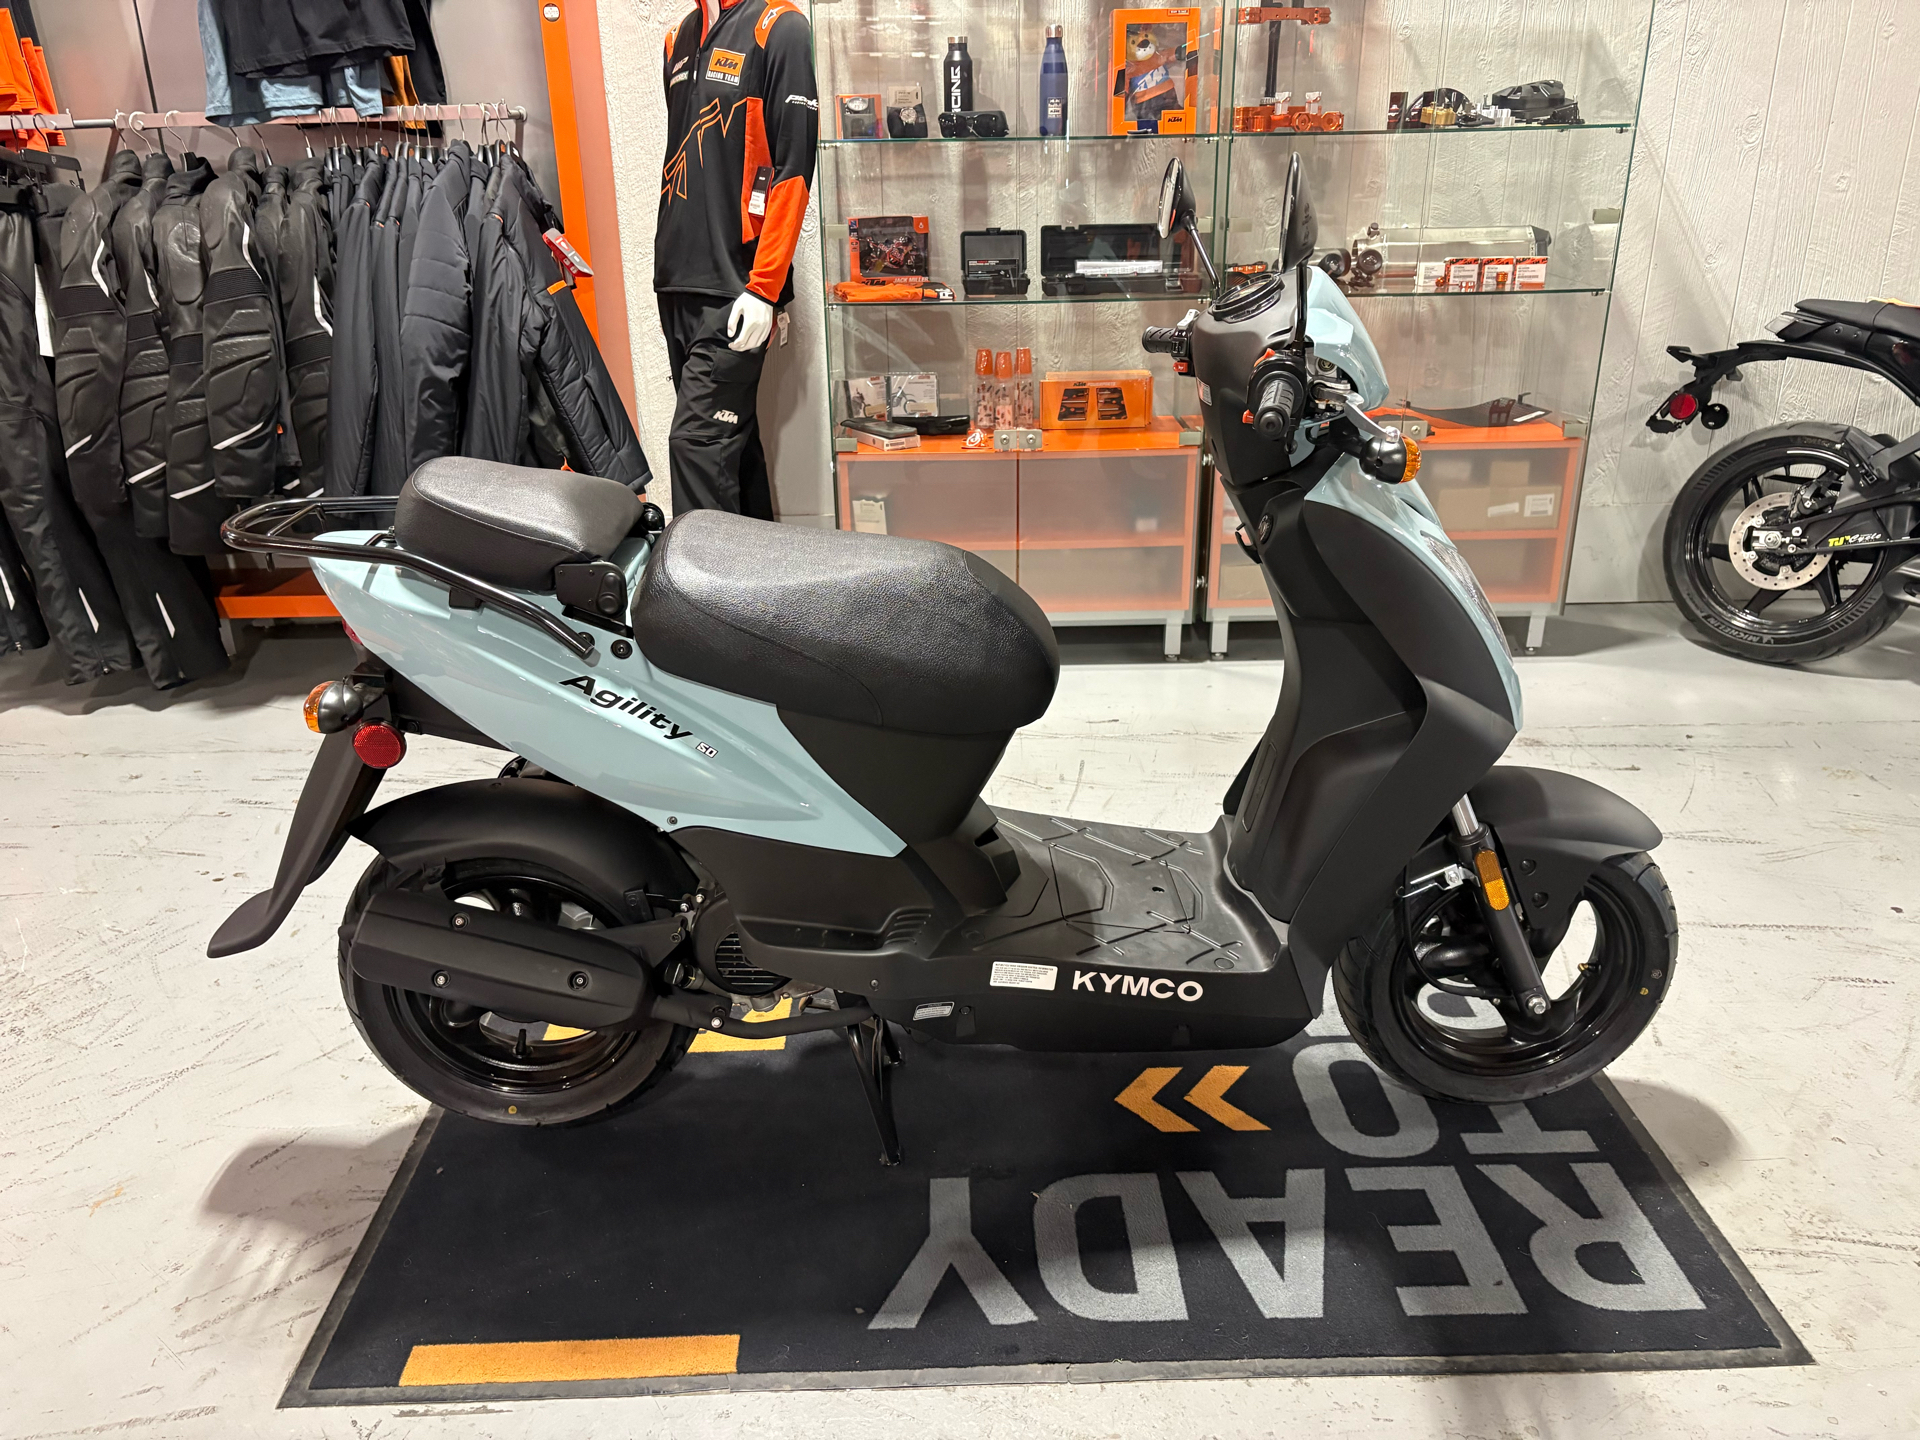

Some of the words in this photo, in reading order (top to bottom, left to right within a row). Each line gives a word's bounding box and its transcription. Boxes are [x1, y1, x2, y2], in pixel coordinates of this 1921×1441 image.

[714, 56, 739, 70] KTM
[706, 70, 724, 80] RACING
[724, 73, 740, 83] TEAM
[1133, 64, 1168, 95] KTM
[909, 276, 929, 284] MILLER
[712, 409, 739, 425] KTM
[1849, 532, 1883, 544] Cycle
[1706, 614, 1761, 643] MICHELIN
[558, 675, 694, 740] Agility
[696, 741, 719, 758] 50
[1072, 970, 1204, 1002] KYMCO
[866, 1161, 1707, 1330] READY
